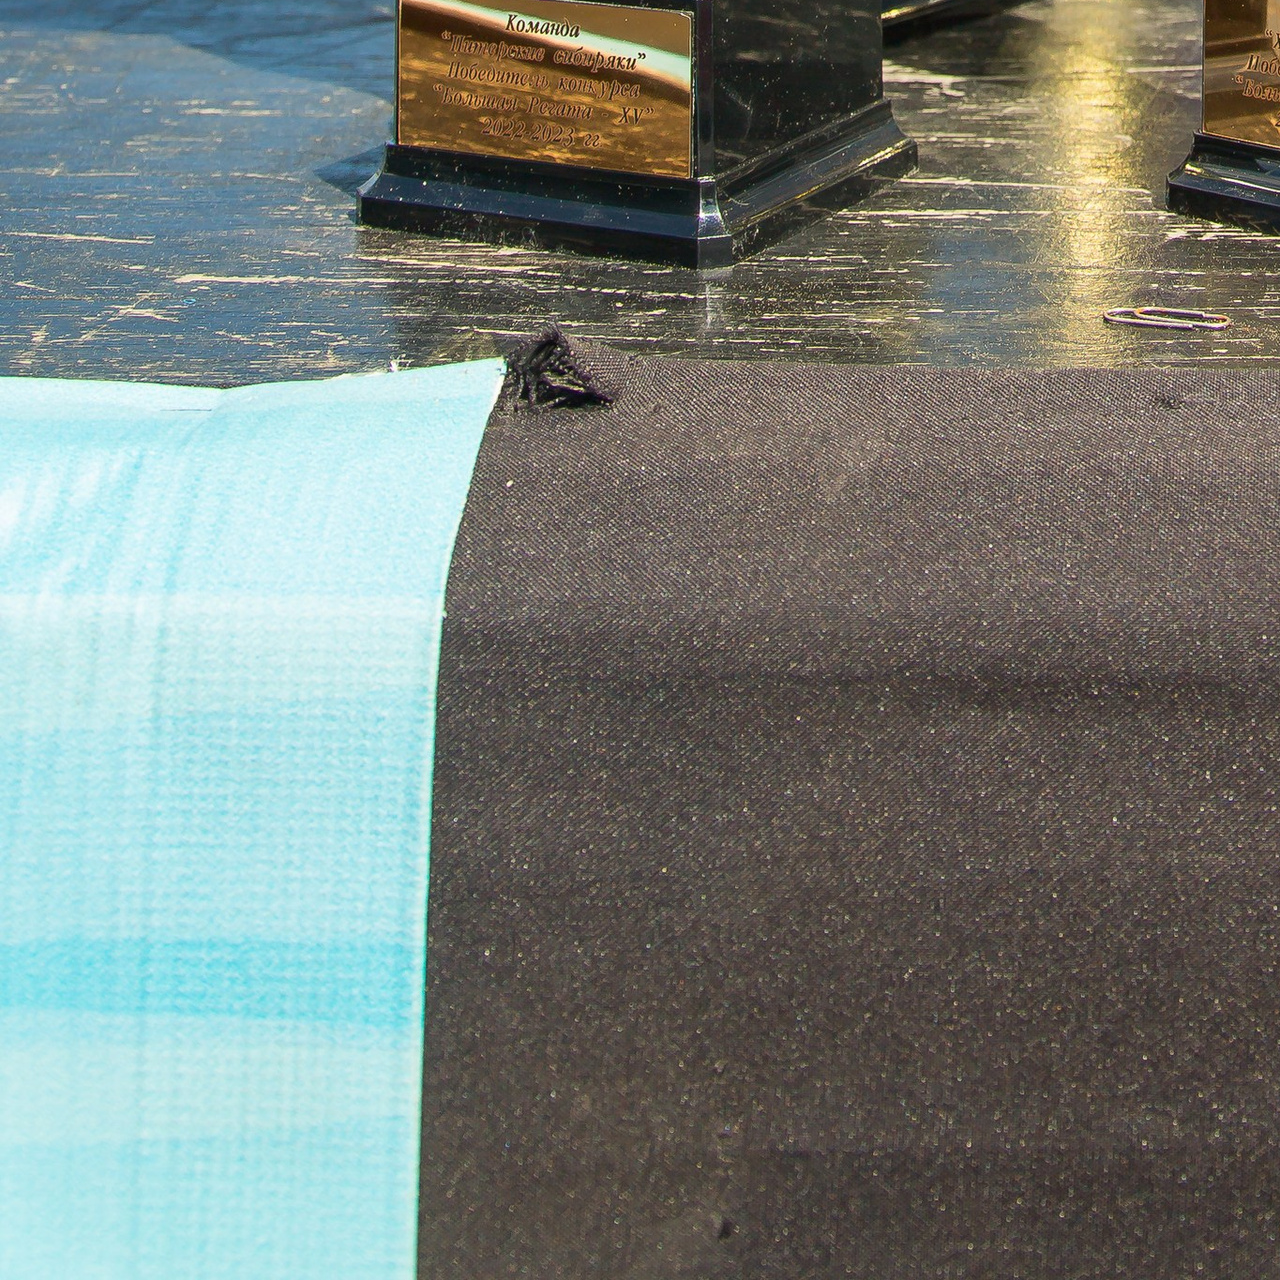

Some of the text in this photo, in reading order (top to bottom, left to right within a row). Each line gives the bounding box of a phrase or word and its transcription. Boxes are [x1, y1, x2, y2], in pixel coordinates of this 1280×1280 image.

[505, 14, 581, 38] Команда
[441, 30, 646, 72] “Питерские сибиряки”
[446, 61, 640, 100] Победитель конкурса
[433, 84, 518, 111] “Большая
[526, 96, 593, 119] Регата
[482, 117, 576, 147] 2022-2023
